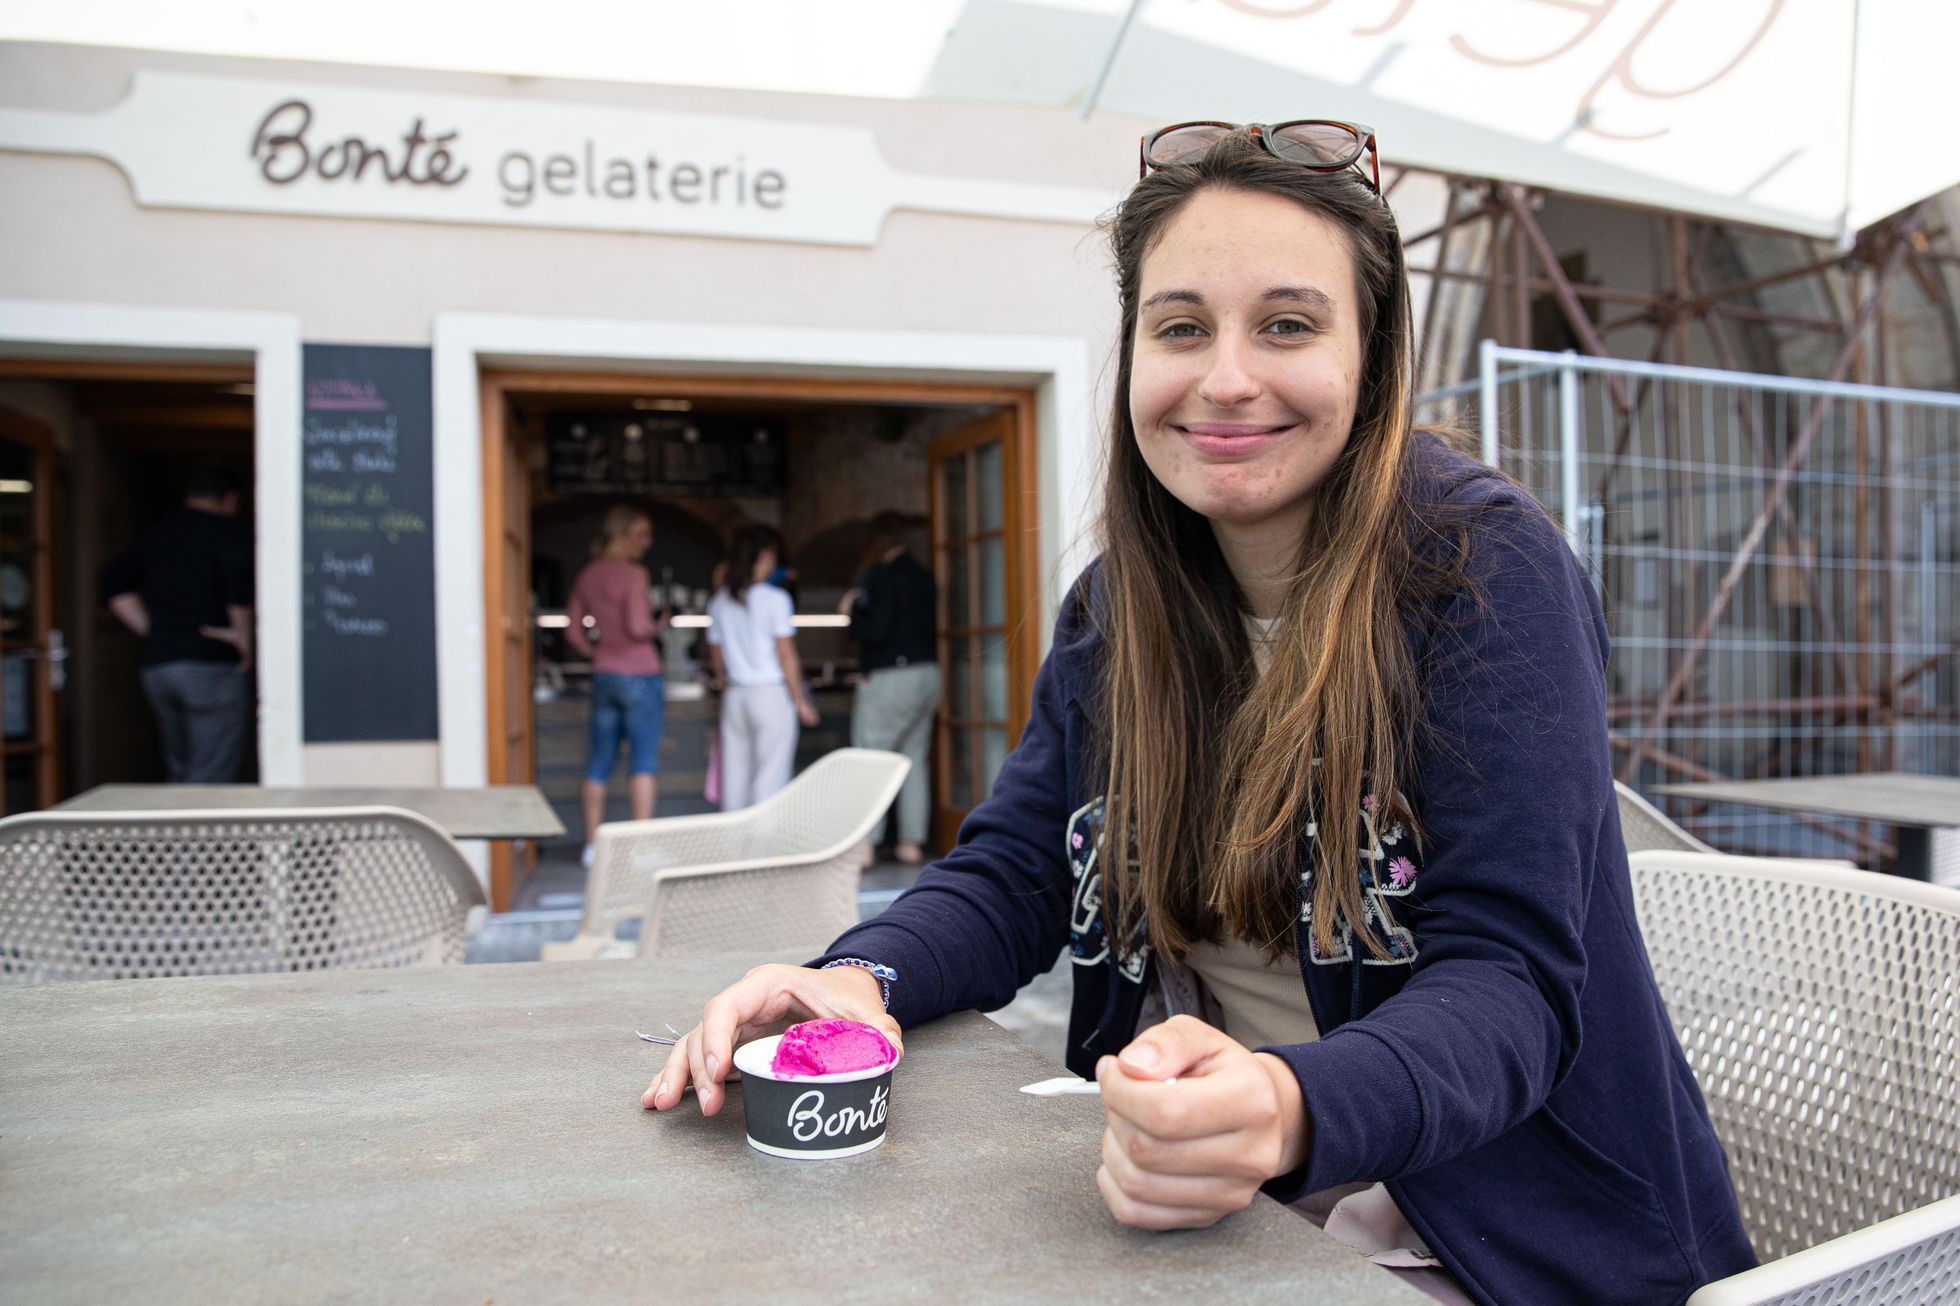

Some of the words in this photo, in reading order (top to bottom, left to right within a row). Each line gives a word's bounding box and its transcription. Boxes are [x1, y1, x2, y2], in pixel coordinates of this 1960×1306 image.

[251, 99, 468, 186] Bonté
[498, 139, 787, 209] gelaterie
[787, 1085, 889, 1141] Bonté
